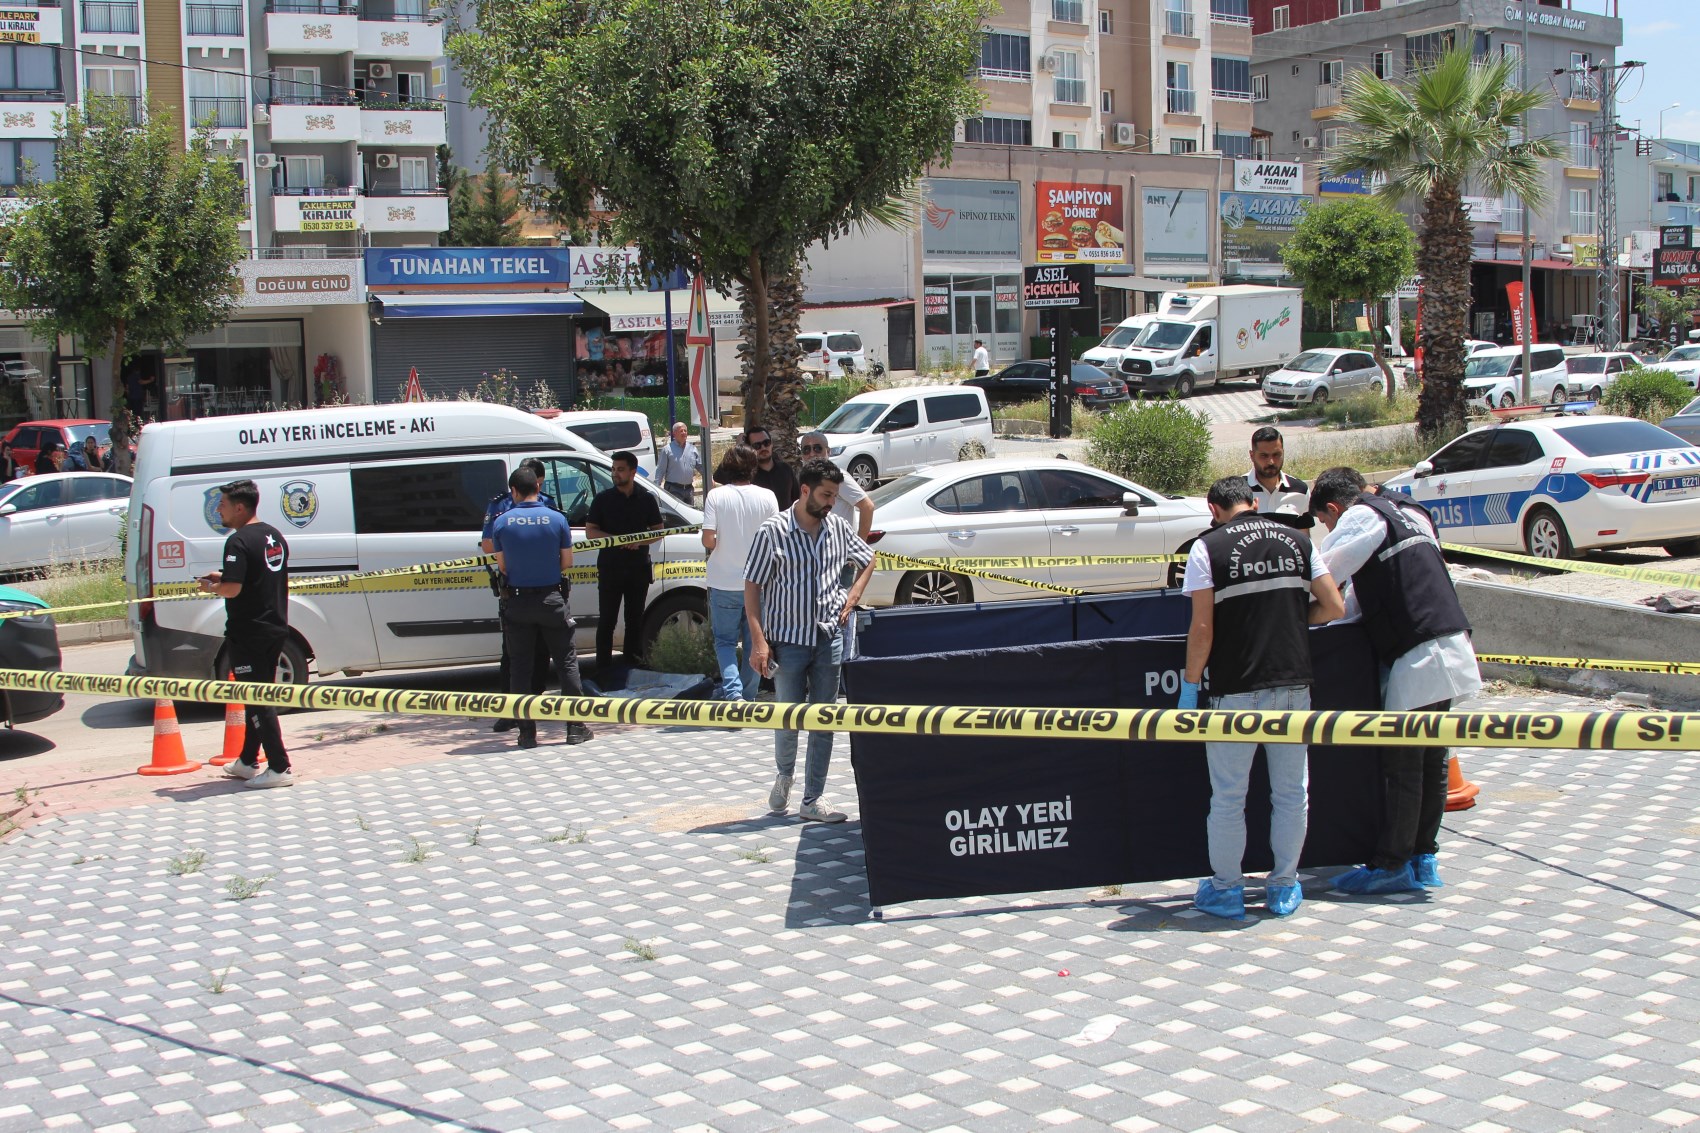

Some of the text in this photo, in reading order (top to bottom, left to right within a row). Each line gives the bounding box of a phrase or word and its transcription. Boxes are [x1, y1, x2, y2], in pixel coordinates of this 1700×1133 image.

[1540, 13, 1562, 27] ORBAY
[1562, 15, 1586, 31] İNŞAAT
[28, 34, 35, 42] 41
[1254, 165, 1298, 178] AKANA
[1263, 178, 1289, 186] TARIM
[1048, 187, 1112, 208] ŞAMPİYON
[1147, 195, 1166, 205] ANT
[1248, 199, 1302, 216] AKANA
[959, 210, 1016, 221] İSPİNOZ TEKNİK
[1260, 216, 1292, 225] TARIM
[303, 222, 320, 230] 0530
[321, 222, 333, 230] 337
[1660, 250, 1694, 263] UMUT
[390, 257, 550, 276] TUNAHAN TEKEL
[1034, 267, 1069, 282] ASEL
[259, 277, 348, 291] DOĞUM GÜNÜ
[1024, 281, 1080, 299] ÇİÇEKÇİLİK
[616, 317, 656, 329] ASEL
[239, 428, 278, 445] OLAY
[1553, 458, 1564, 468] 112
[1657, 480, 1666, 490] 01
[1430, 500, 1463, 526] OLİS
[1225, 520, 1291, 534] KRİMİNAL
[161, 544, 181, 557] 112
[1230, 529, 1304, 578] OLAY YERİ İNCELEME
[665, 566, 680, 574] OLAY
[1242, 556, 1296, 577] POLİS
[413, 578, 430, 586] OLAY
[158, 587, 175, 597] OLAY
[945, 795, 1072, 831] OLAY YERİ
[950, 827, 1069, 857] GİRİLMEZ
